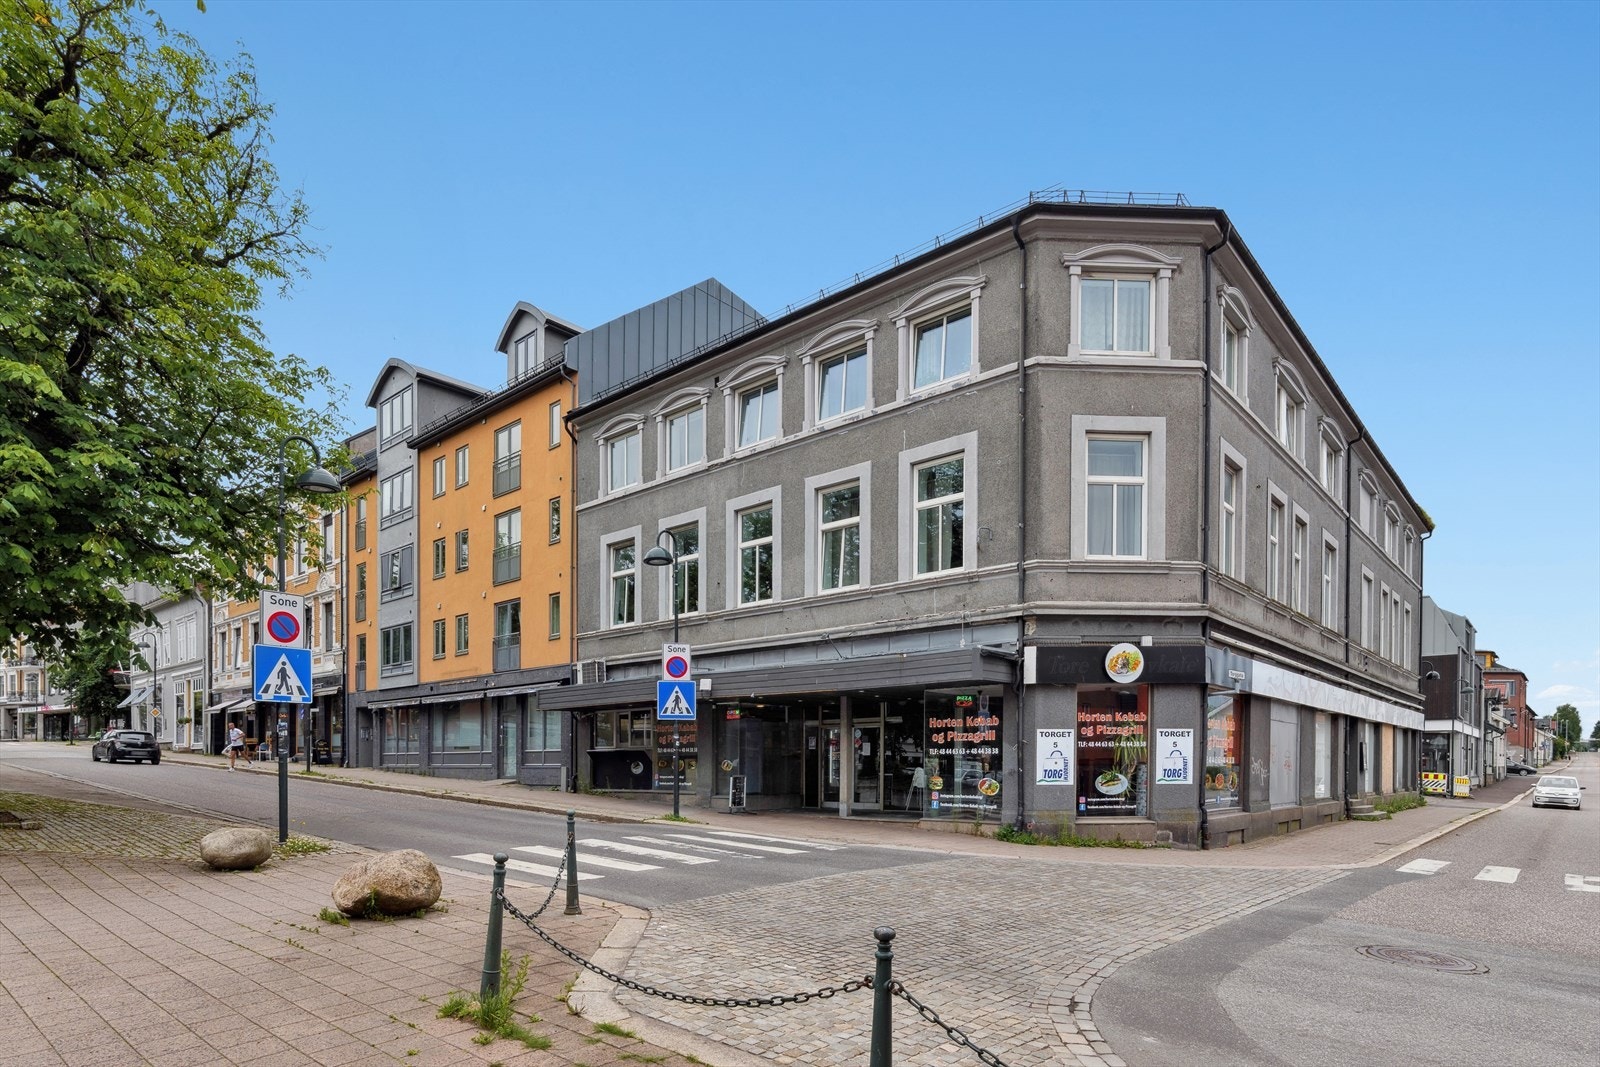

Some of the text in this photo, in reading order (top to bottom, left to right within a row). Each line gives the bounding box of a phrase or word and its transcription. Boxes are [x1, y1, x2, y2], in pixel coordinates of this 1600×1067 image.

[270, 595, 298, 608] Sone
[667, 645, 686, 653] Sone
[929, 715, 1000, 728] Horten Kebab
[1078, 712, 1147, 722] Horten Kebab
[1081, 725, 1144, 736] og Pizzagrill
[668, 734, 696, 743] Piagrill
[932, 730, 996, 744] og Pizzagrill
[1043, 769, 1063, 779] TORG
[1163, 769, 1182, 778] TORG
